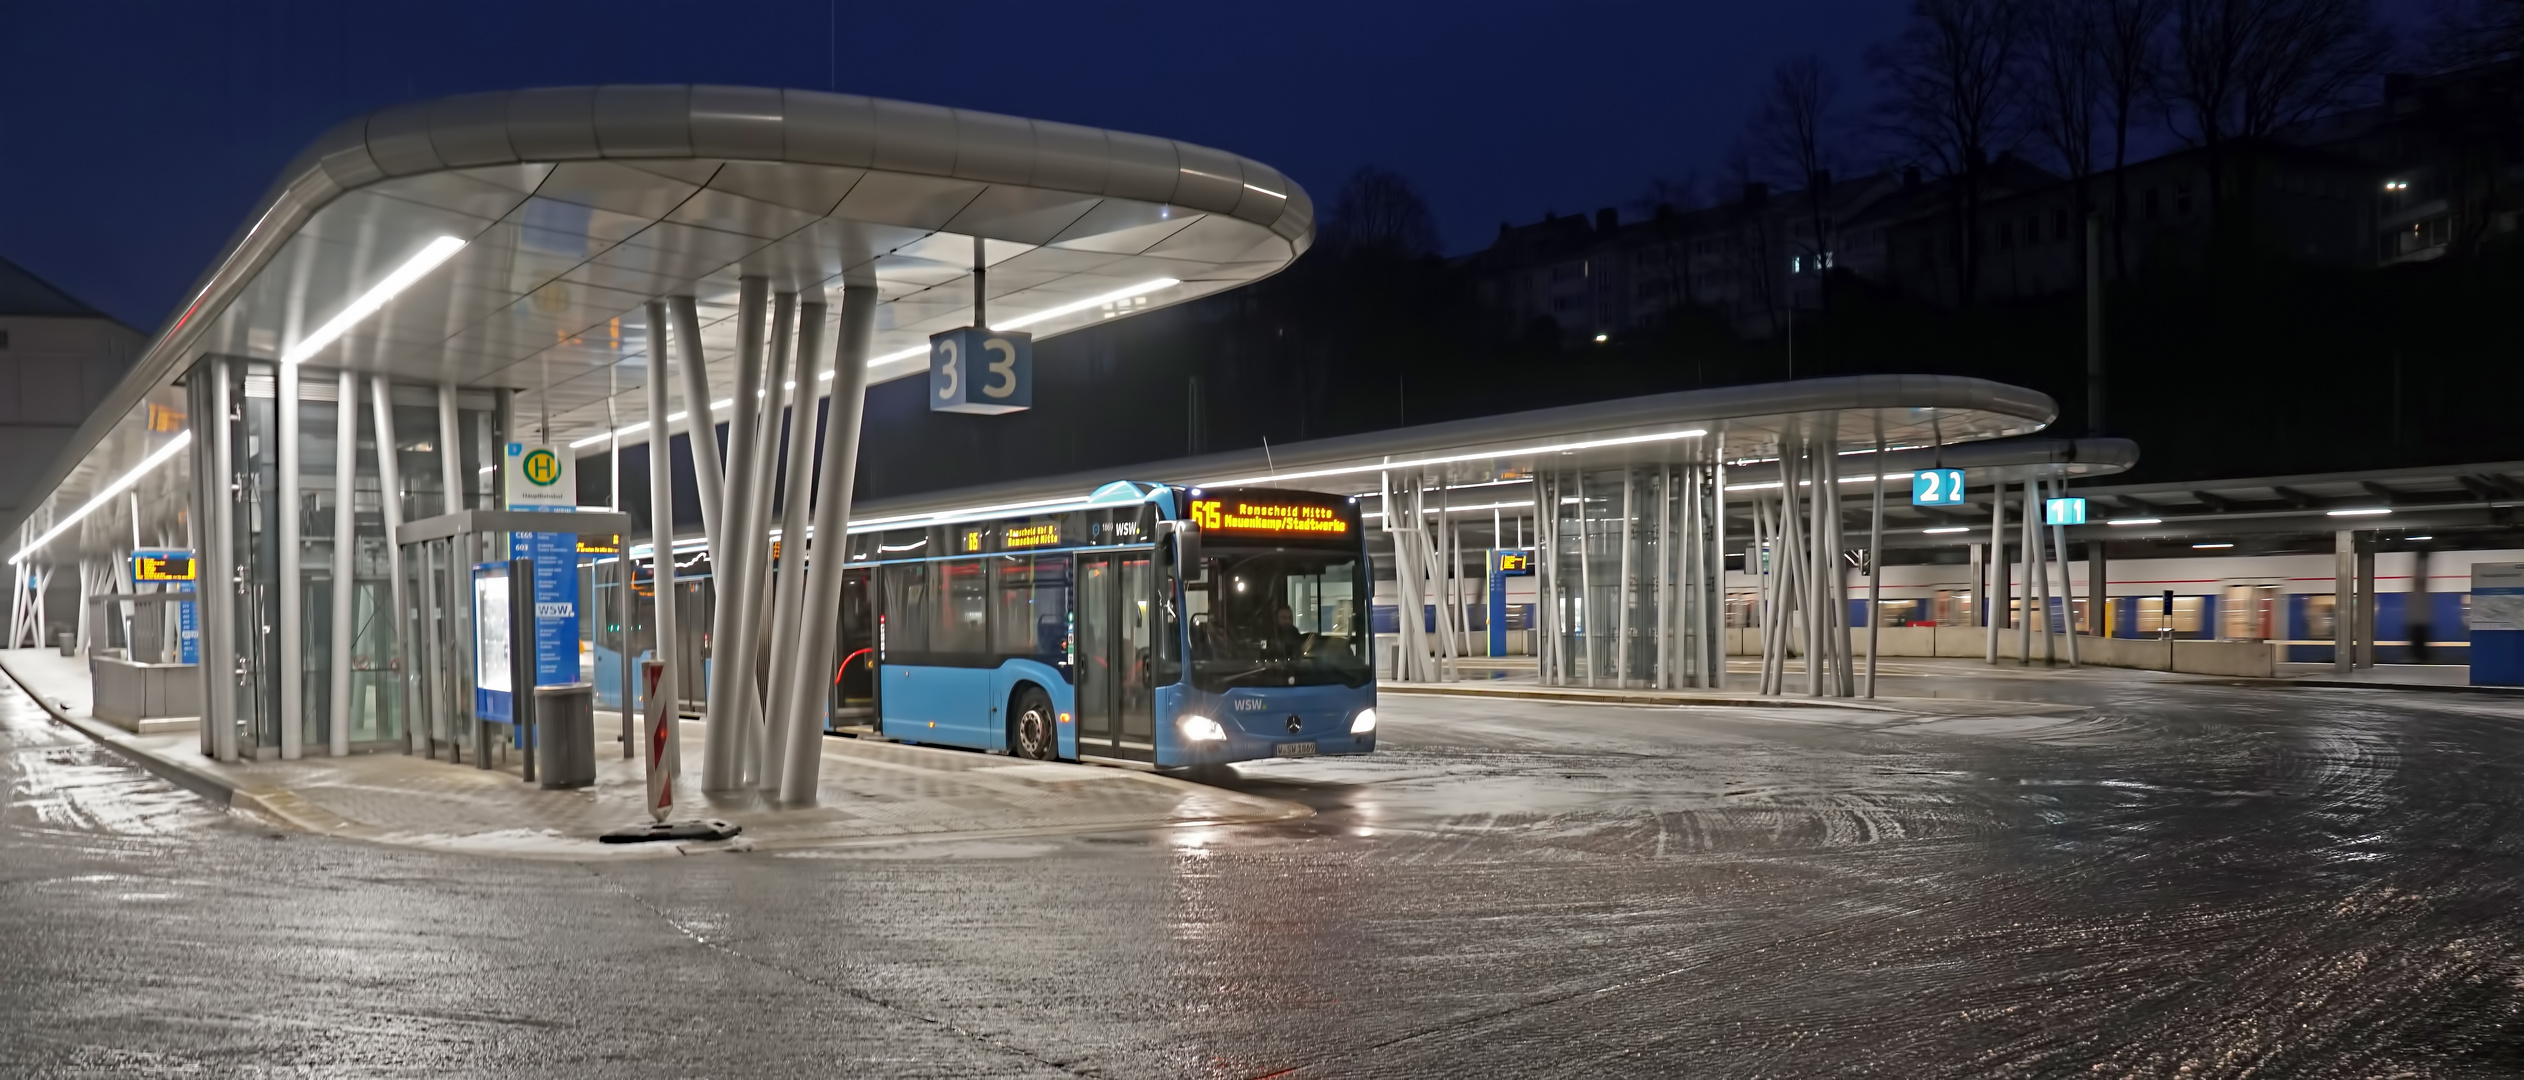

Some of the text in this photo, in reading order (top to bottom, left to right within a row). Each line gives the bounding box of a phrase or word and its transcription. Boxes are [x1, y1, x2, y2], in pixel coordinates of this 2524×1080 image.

[939, 339, 958, 399] 3
[982, 338, 1016, 398] 3
[534, 457, 551, 478] H
[1919, 471, 1940, 502] 2
[1949, 471, 1961, 501] 2
[1192, 501, 1221, 528] 615
[1224, 514, 1346, 532] Neuenkamp/Stadtwerke
[1239, 503, 1333, 519] Remscheid Mitte
[2051, 499, 2064, 522] 1
[2073, 499, 2082, 522] 1
